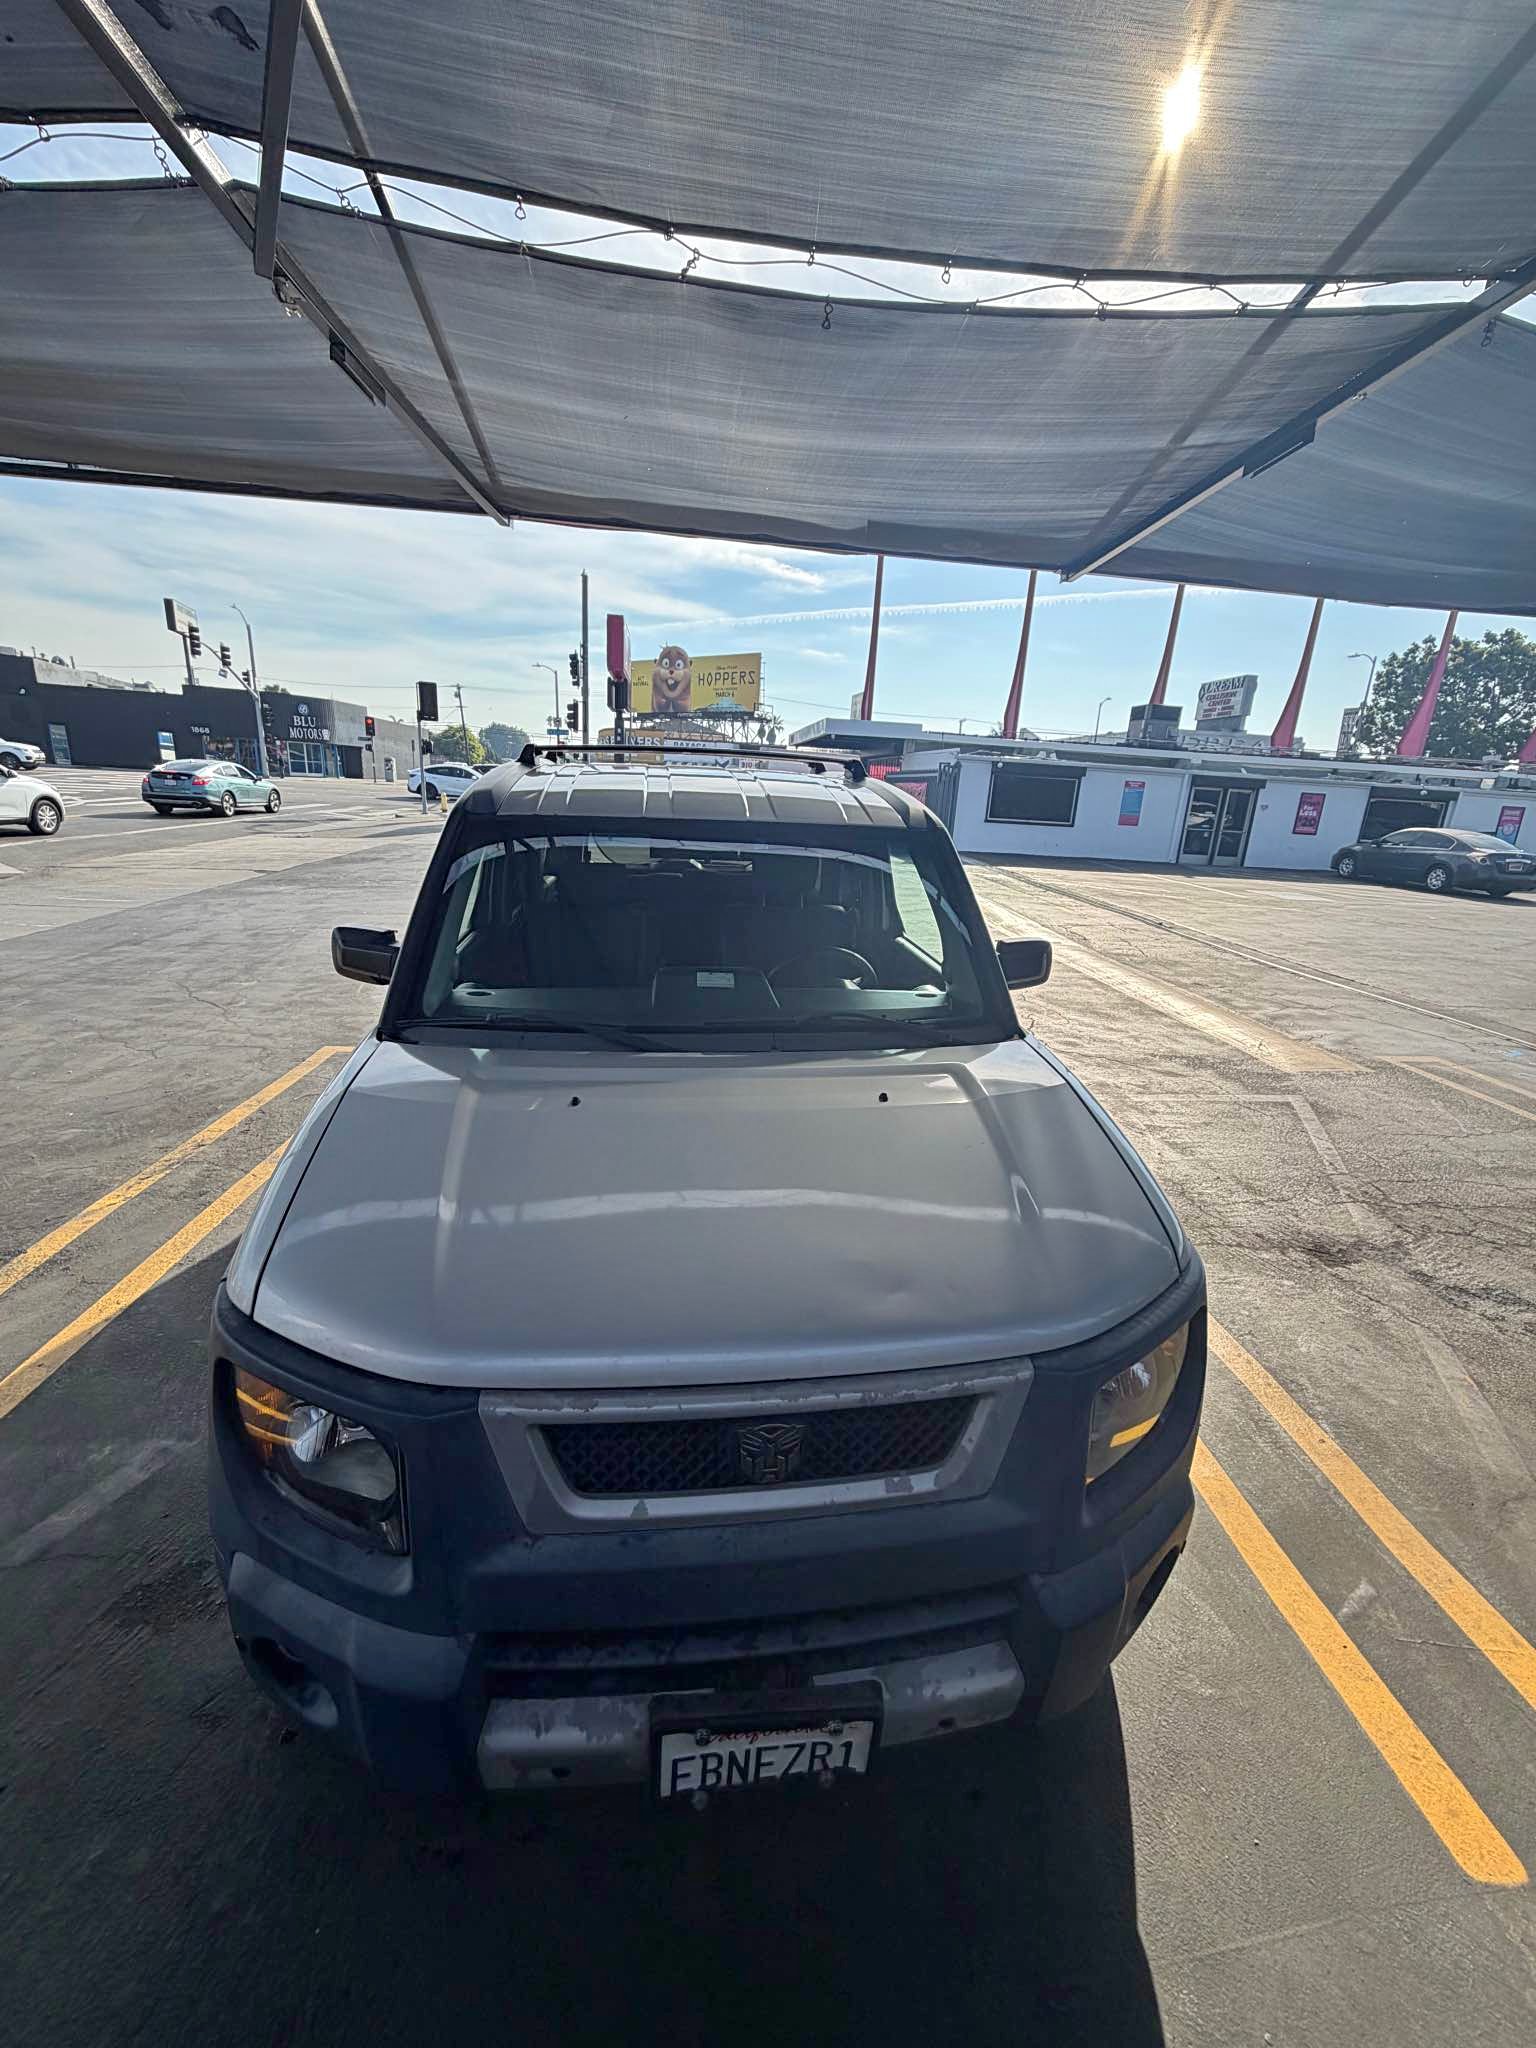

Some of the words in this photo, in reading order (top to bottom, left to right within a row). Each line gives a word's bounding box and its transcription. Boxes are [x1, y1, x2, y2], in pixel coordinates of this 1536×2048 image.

[698, 670, 756, 687] HOPPERS
[1205, 690, 1238, 701] COLLISION
[293, 715, 316, 727] BLU
[289, 727, 323, 740] MOTORS
